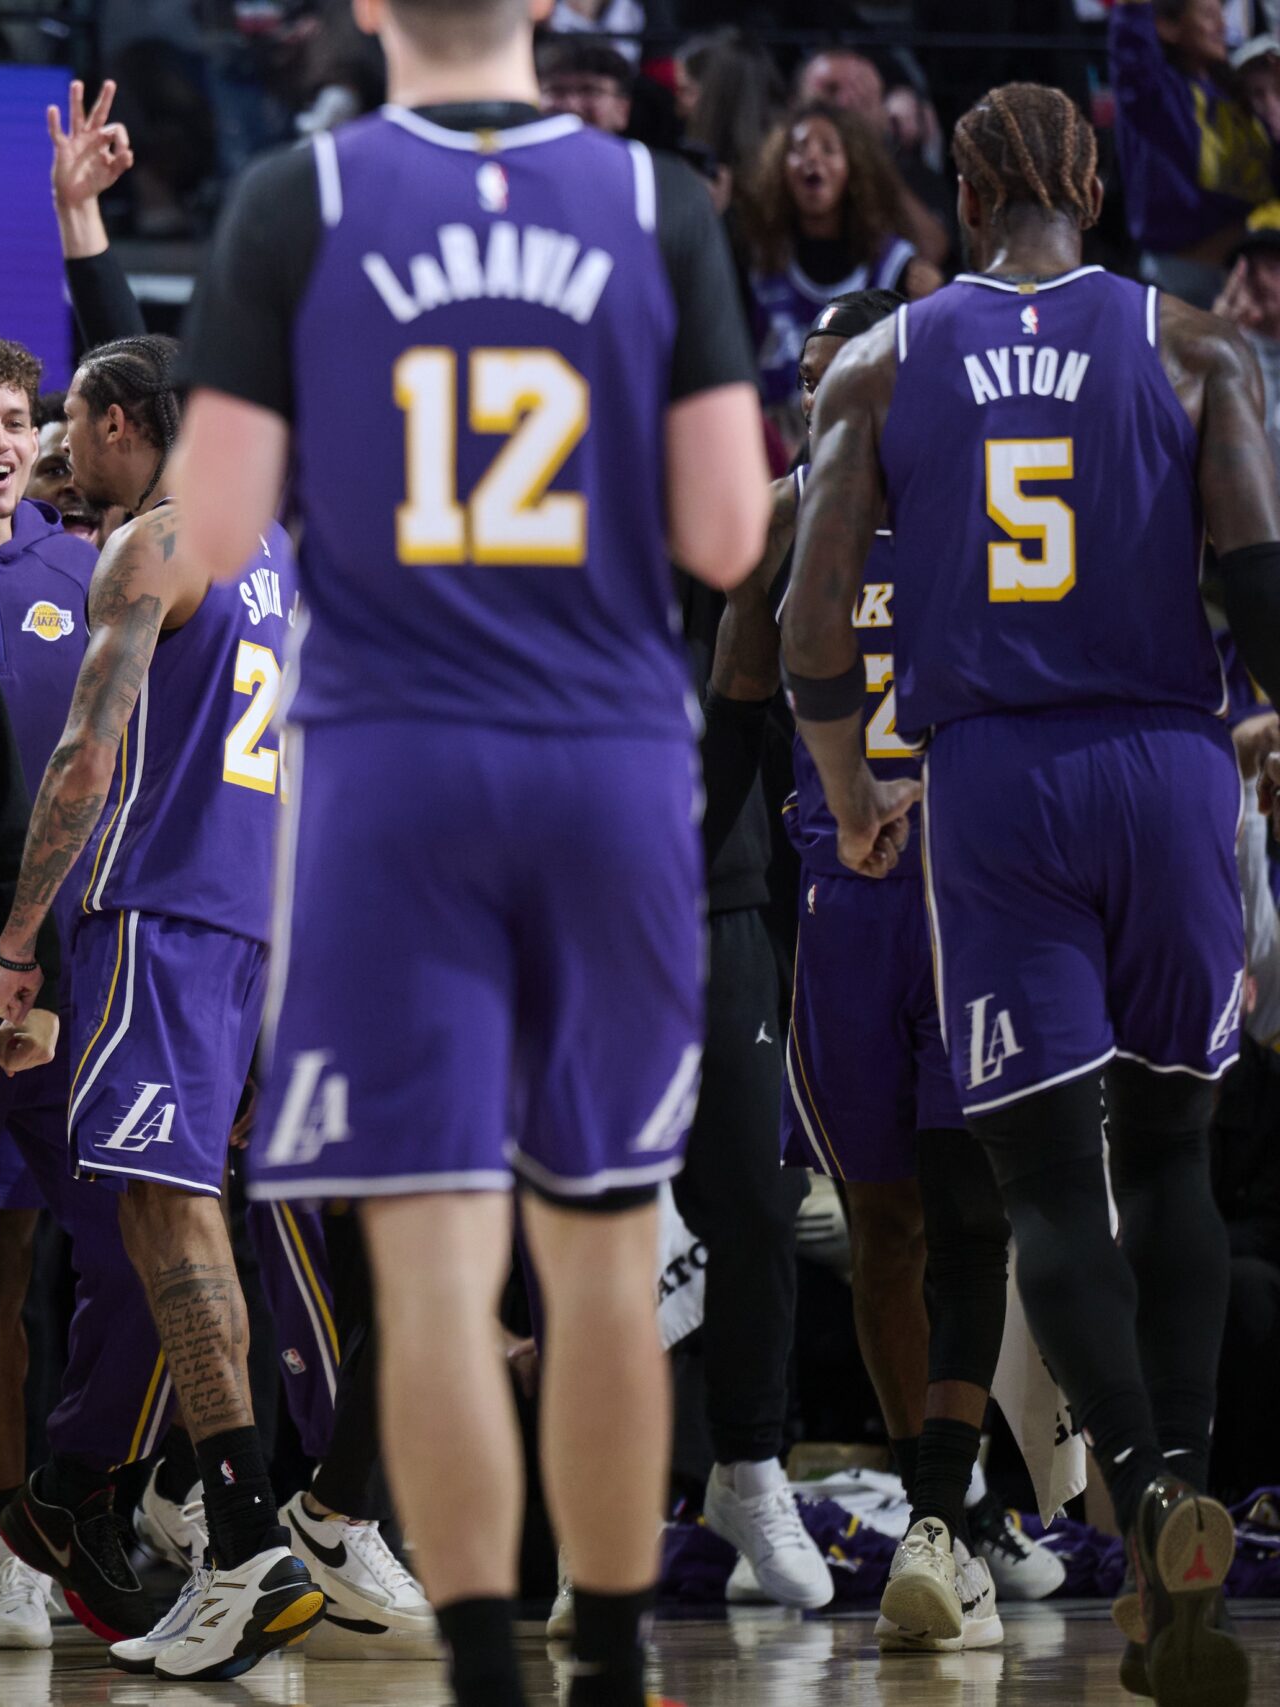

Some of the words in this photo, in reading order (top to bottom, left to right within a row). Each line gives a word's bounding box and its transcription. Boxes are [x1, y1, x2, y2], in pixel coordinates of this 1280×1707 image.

[394, 345, 589, 566] 12
[963, 345, 1090, 405] AYTON
[985, 437, 1076, 602] 5
[223, 640, 289, 806] 2
[95, 1081, 176, 1152] LA
